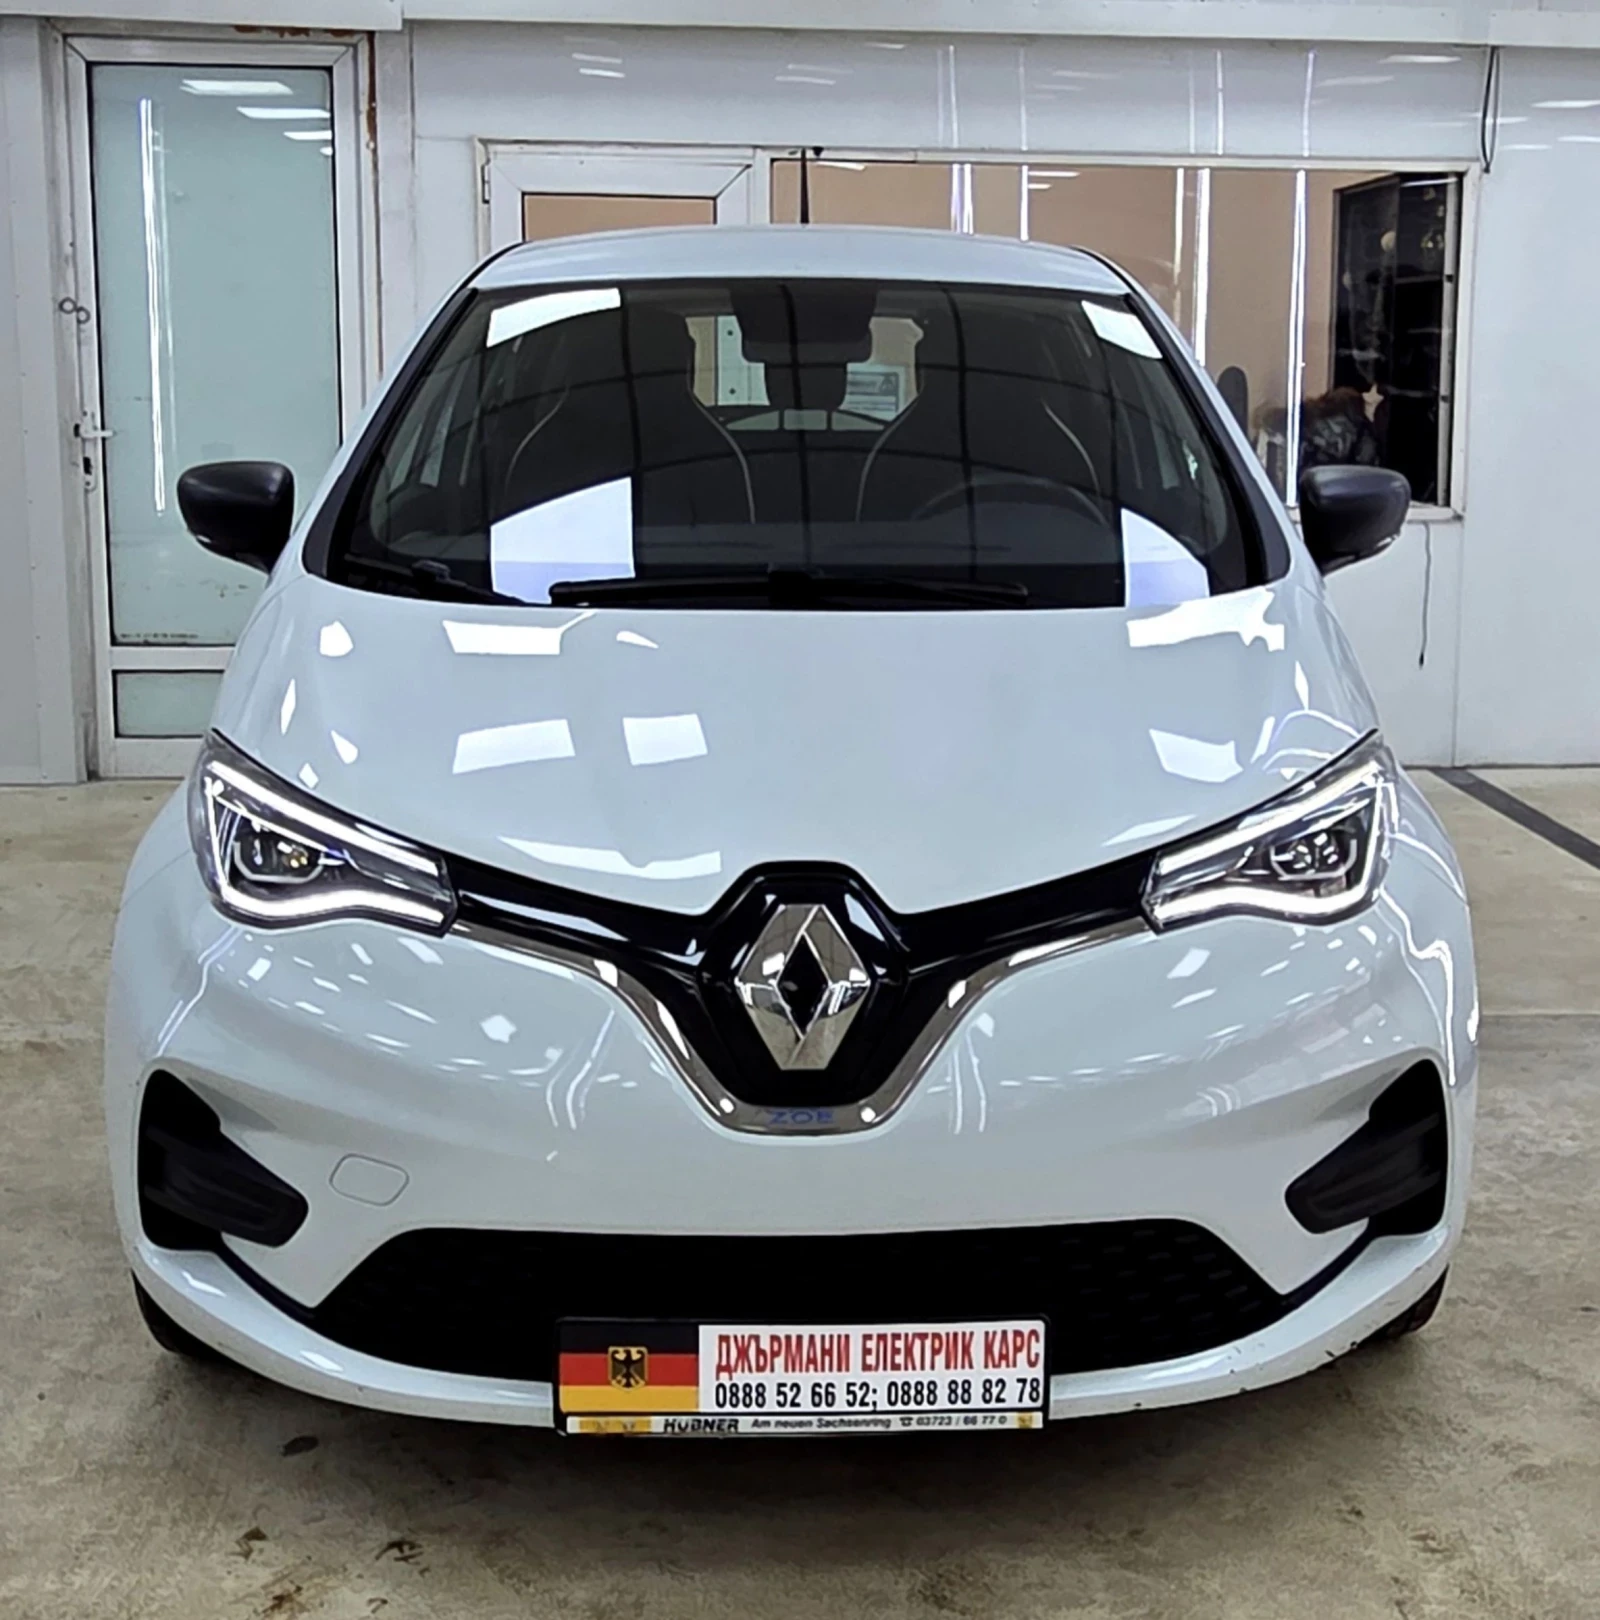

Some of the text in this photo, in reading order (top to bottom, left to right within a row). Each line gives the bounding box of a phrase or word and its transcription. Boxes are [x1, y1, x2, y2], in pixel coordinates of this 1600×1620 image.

[768, 1110, 834, 1125] ZOE
[716, 1329, 1040, 1380] ДЖЪРМАНИ ЕЛЕКТРИК КАРС
[715, 1377, 1041, 1411] 0888 52 66 52; 0888 88 82 78
[751, 1418, 772, 1429] Am
